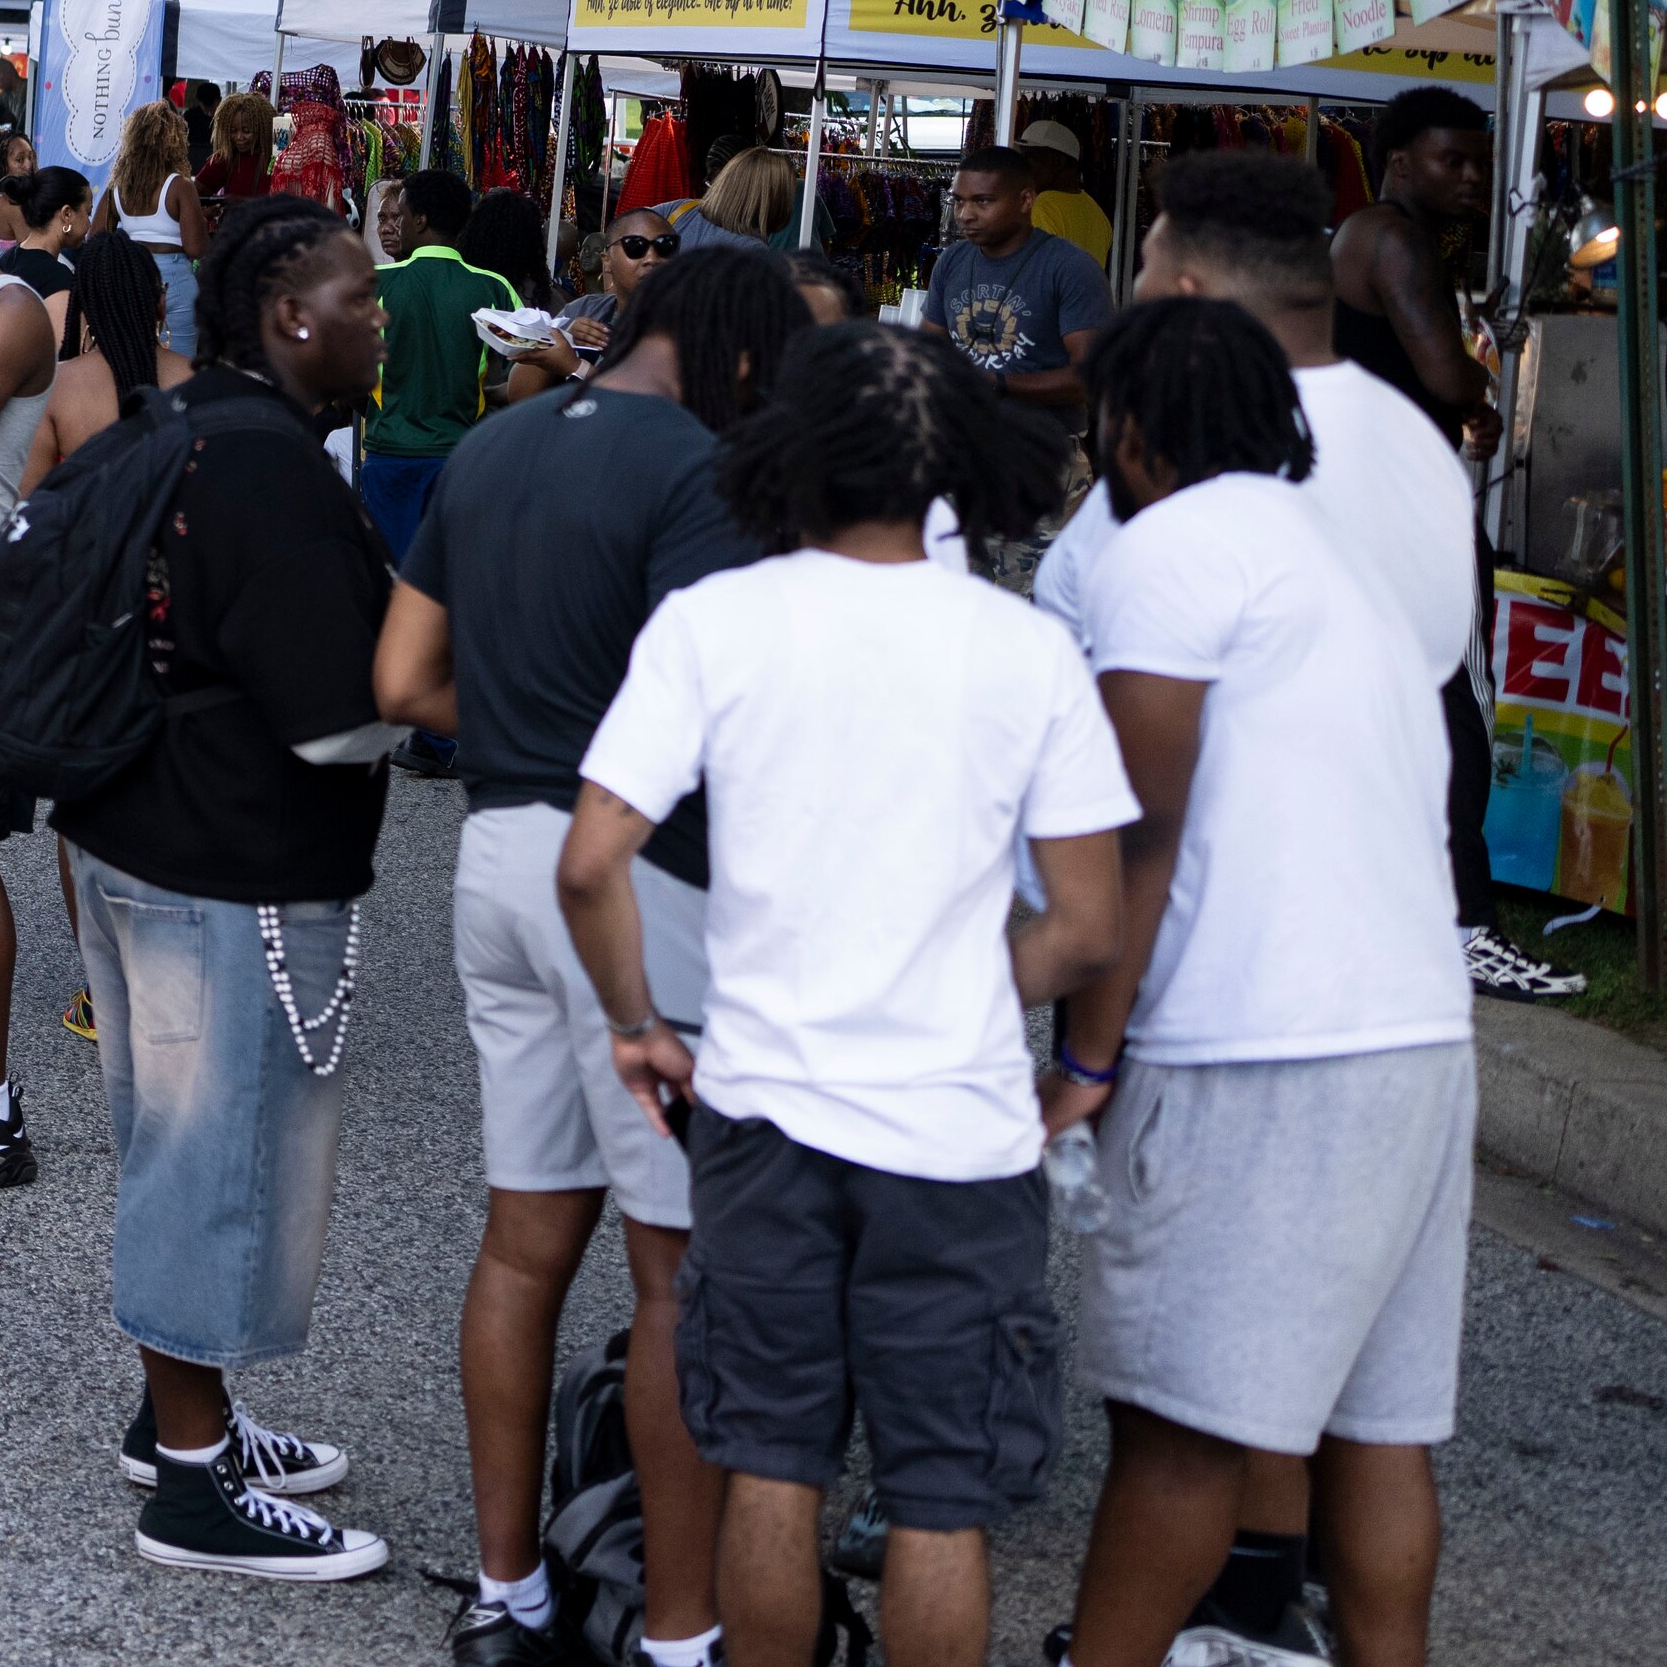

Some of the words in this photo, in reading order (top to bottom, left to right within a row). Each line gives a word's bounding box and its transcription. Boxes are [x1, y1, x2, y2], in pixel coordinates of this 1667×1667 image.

[1182, 0, 1221, 30] Shrimp
[1227, 13, 1247, 42] Egg
[1252, 10, 1274, 36] Roll
[1342, 0, 1387, 32] Noodle
[1178, 31, 1224, 54] Tempura
[93, 48, 112, 140] NOTHING
